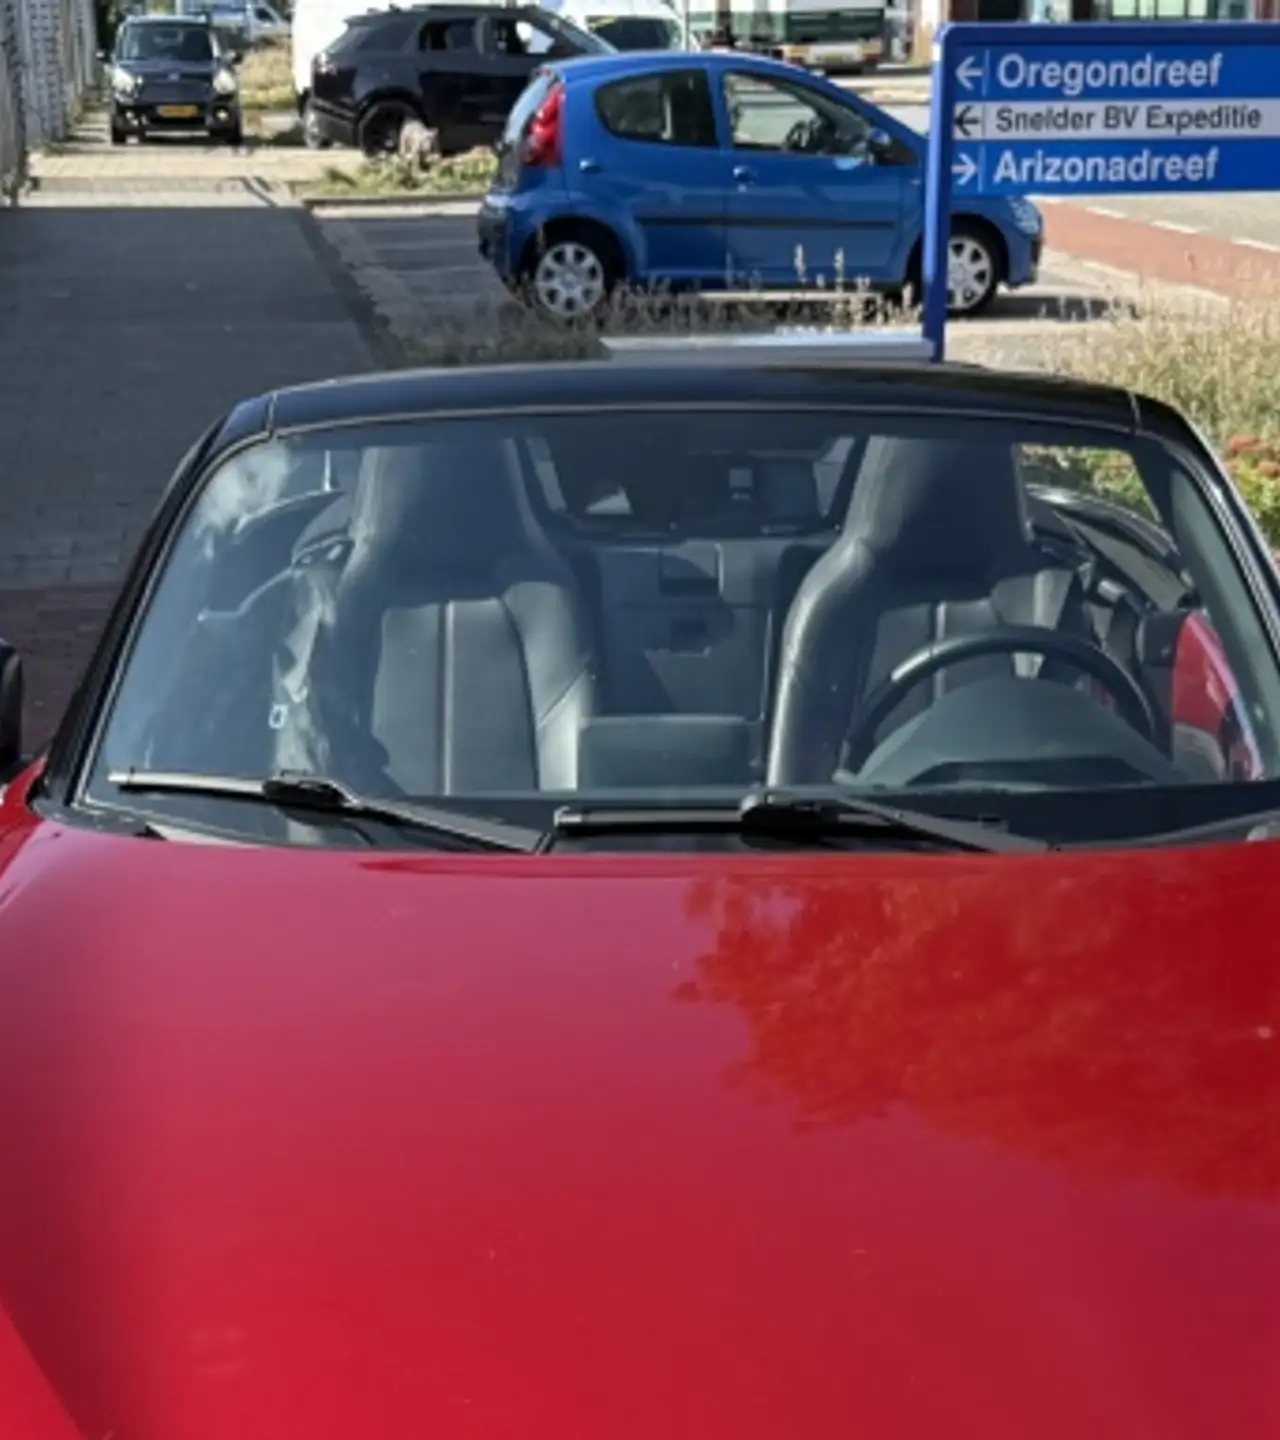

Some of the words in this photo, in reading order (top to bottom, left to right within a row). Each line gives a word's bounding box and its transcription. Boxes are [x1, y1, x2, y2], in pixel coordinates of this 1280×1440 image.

[997, 53, 1222, 95] Oregondreef
[996, 106, 1094, 132] Snelder
[1104, 105, 1139, 130] BV
[1146, 104, 1262, 135] Expeditie
[993, 146, 1218, 184] Arizonadreef
